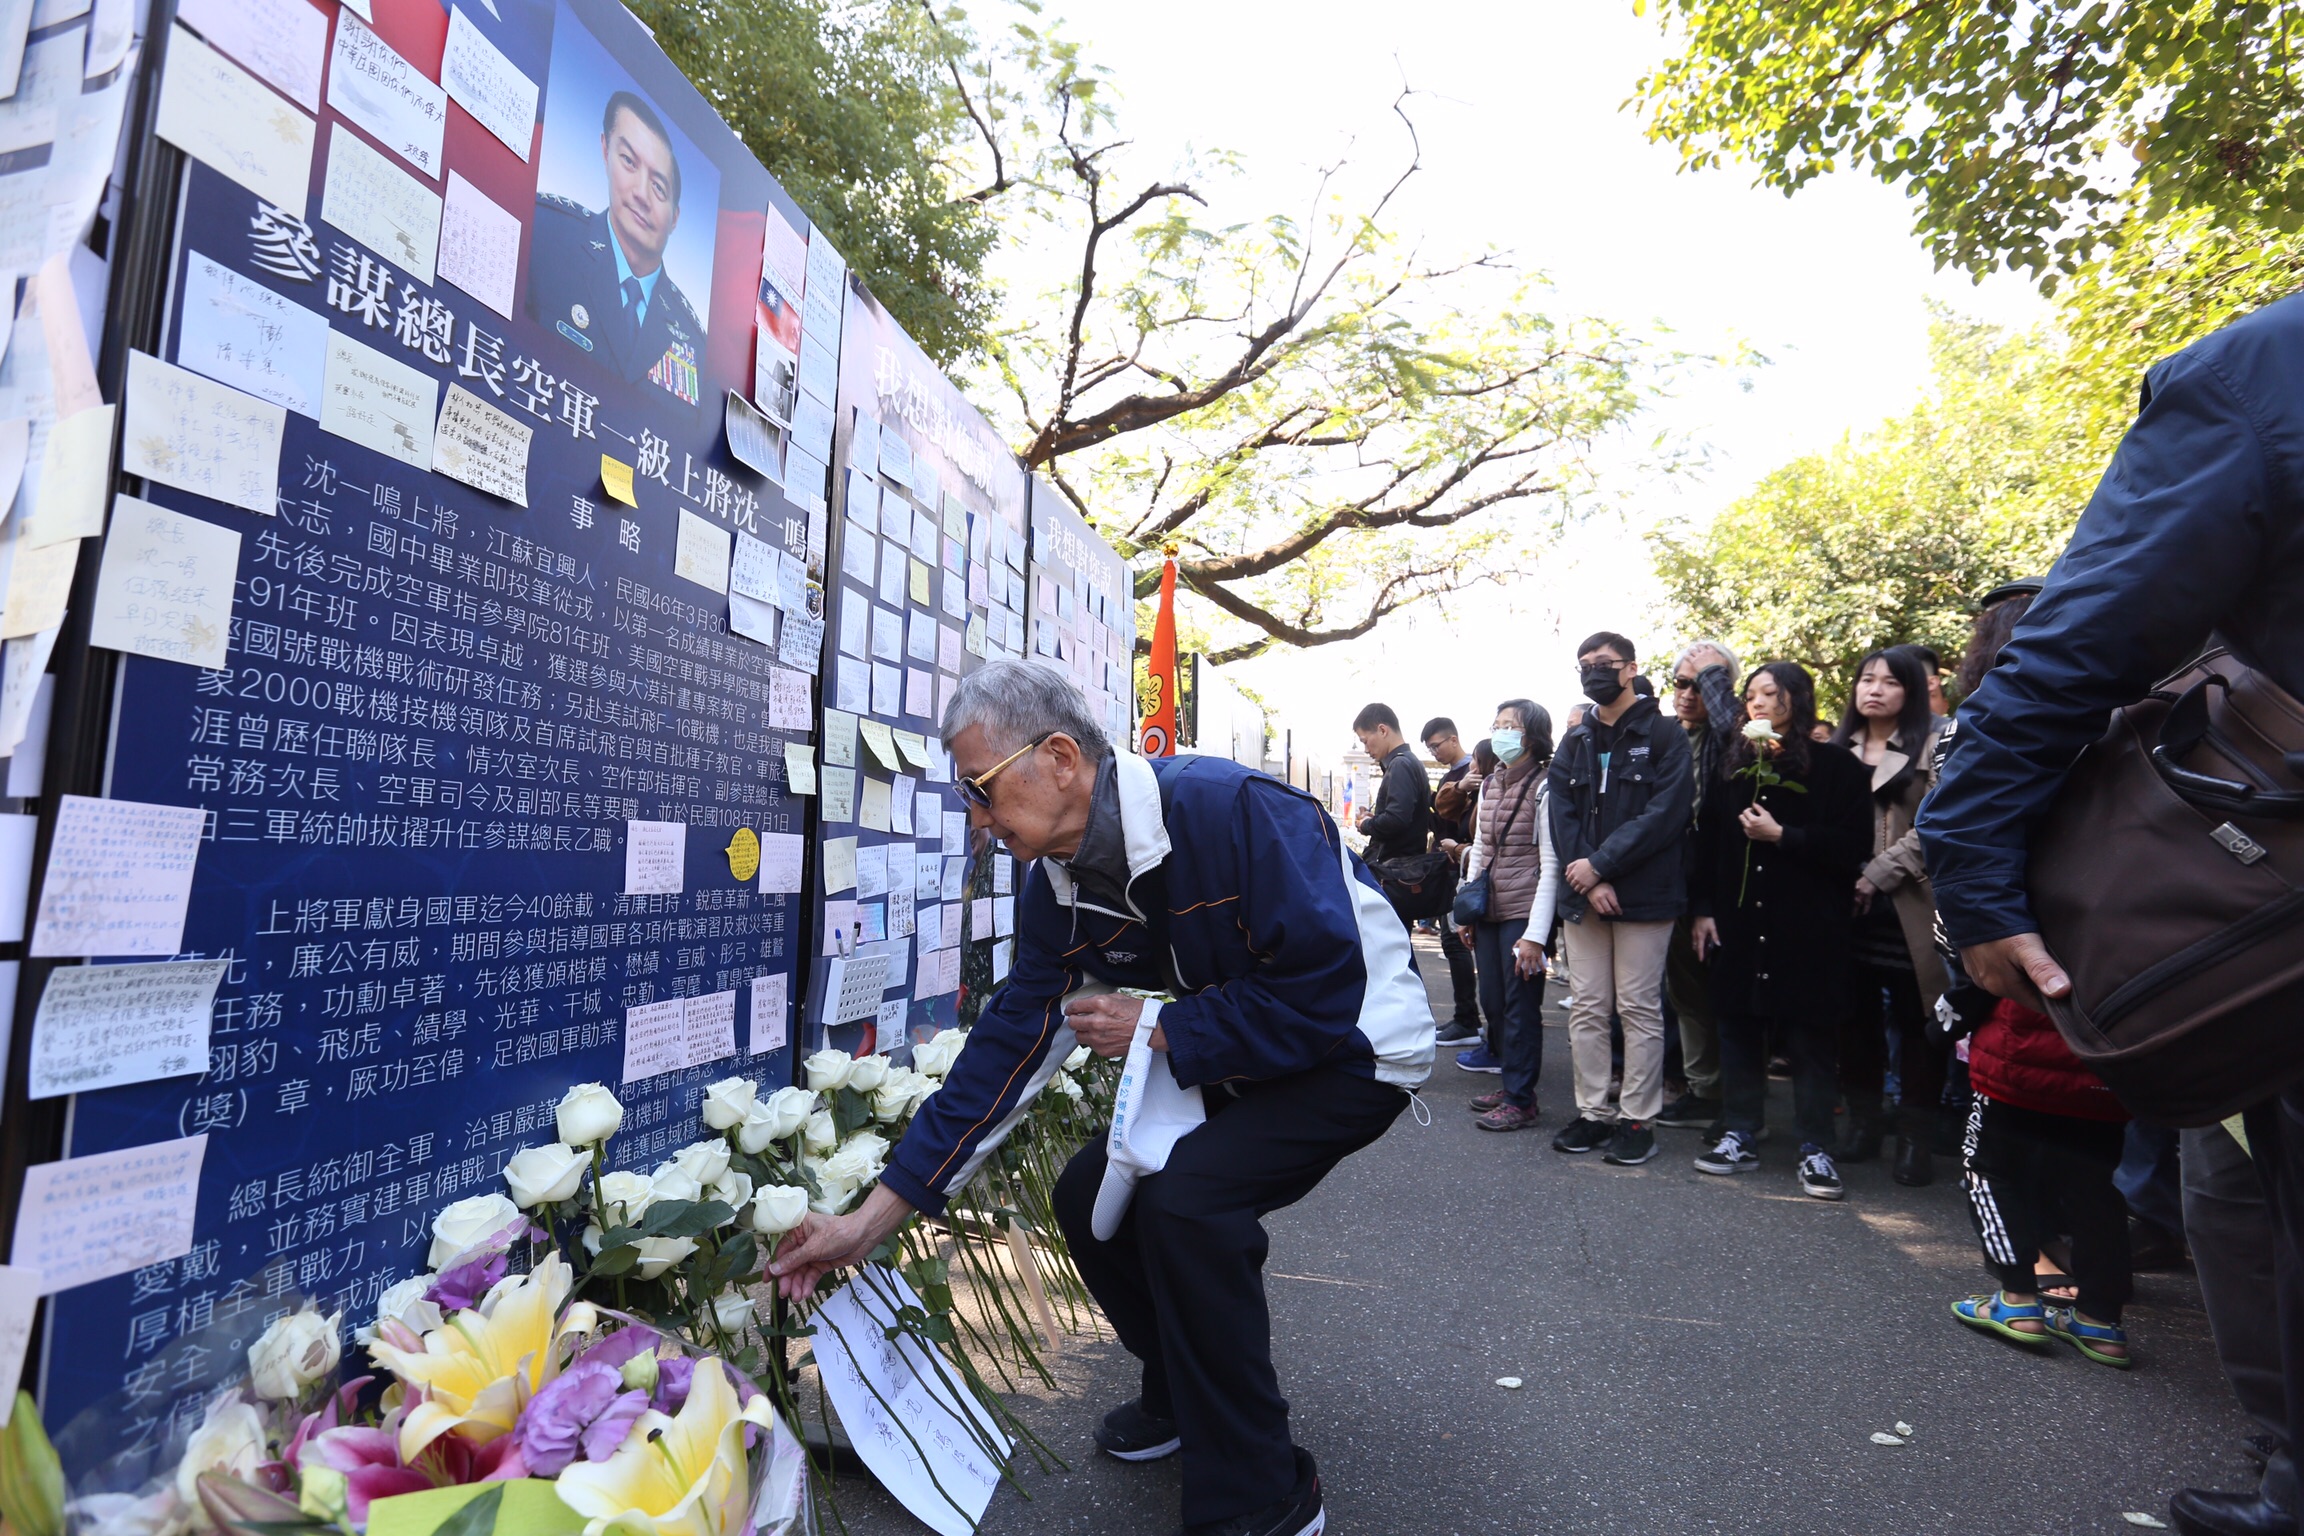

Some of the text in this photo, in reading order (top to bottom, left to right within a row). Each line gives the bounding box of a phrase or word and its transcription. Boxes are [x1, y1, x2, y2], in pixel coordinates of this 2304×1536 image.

[568, 494, 595, 531] 事
[618, 518, 642, 555] 略
[226, 615, 793, 758] 國號戰機戰術研發任務；另赴美試飛F-16戰機；也是我國
[171, 911, 785, 985] 化，廉公有威，期間參與指導國軍各項作戰演習及救災等重
[123, 1203, 453, 1361] 厚植全軍戰力，以
